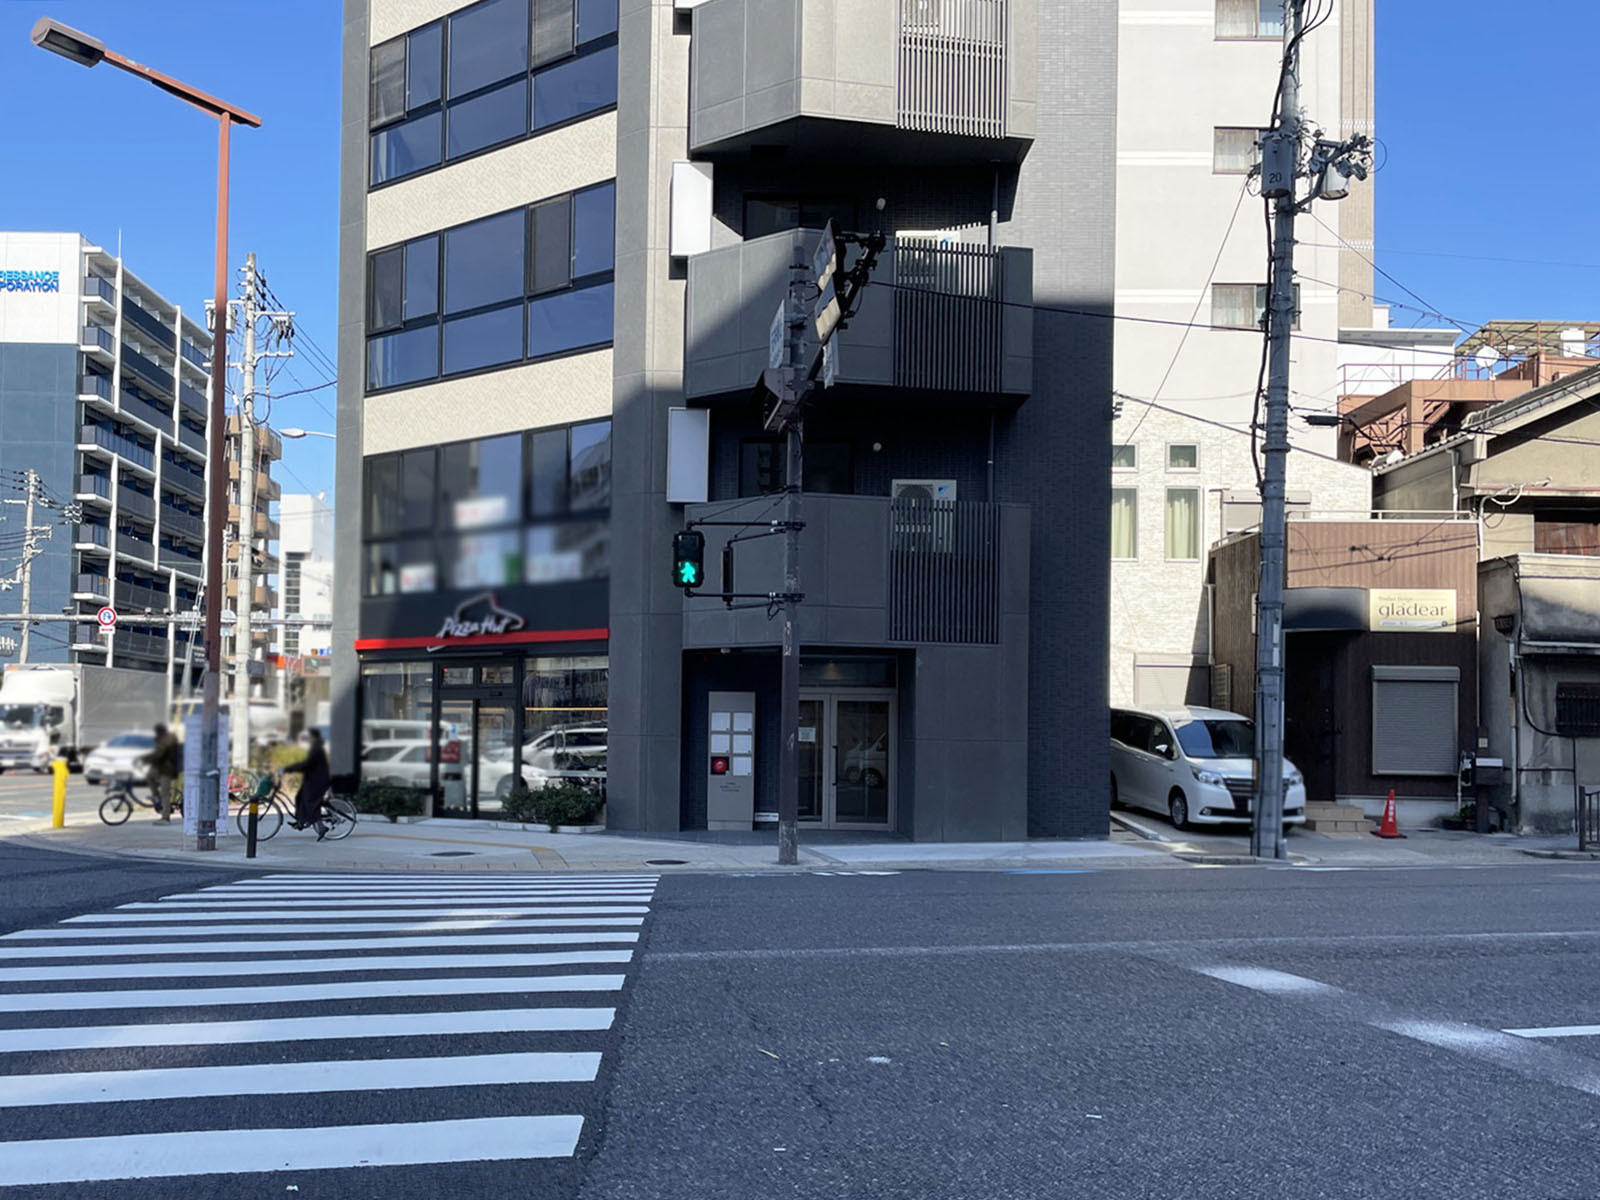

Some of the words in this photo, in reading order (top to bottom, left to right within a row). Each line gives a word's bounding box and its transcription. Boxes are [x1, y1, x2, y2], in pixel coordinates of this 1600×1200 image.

[1269, 172, 1282, 184] 20
[1378, 602, 1448, 618] gladear
[435, 617, 480, 638] Pizza
[480, 614, 512, 635] Hut
